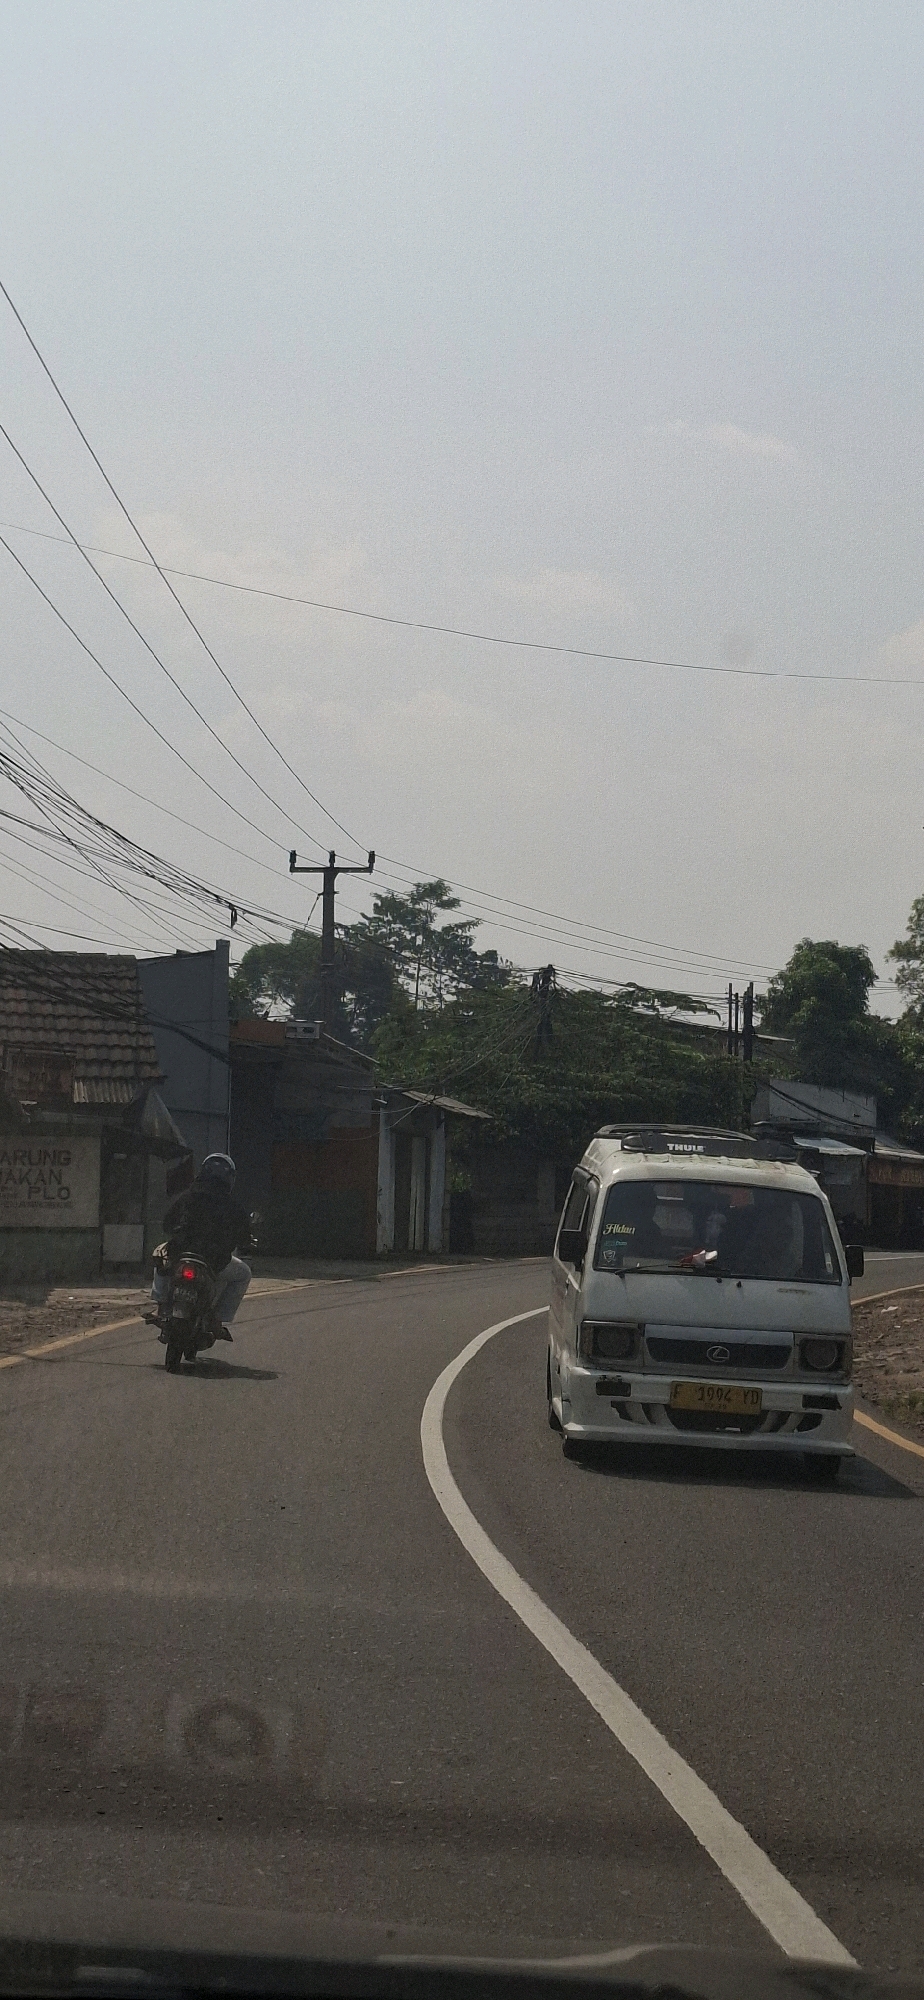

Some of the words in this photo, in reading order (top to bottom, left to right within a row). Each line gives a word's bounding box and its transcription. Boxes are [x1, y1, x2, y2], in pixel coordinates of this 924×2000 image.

[666, 1143, 704, 1152] THULE
[0, 1168, 62, 1185] AKAN
[28, 1186, 71, 1200] PLO
[743, 1390, 760, 1405] YD
